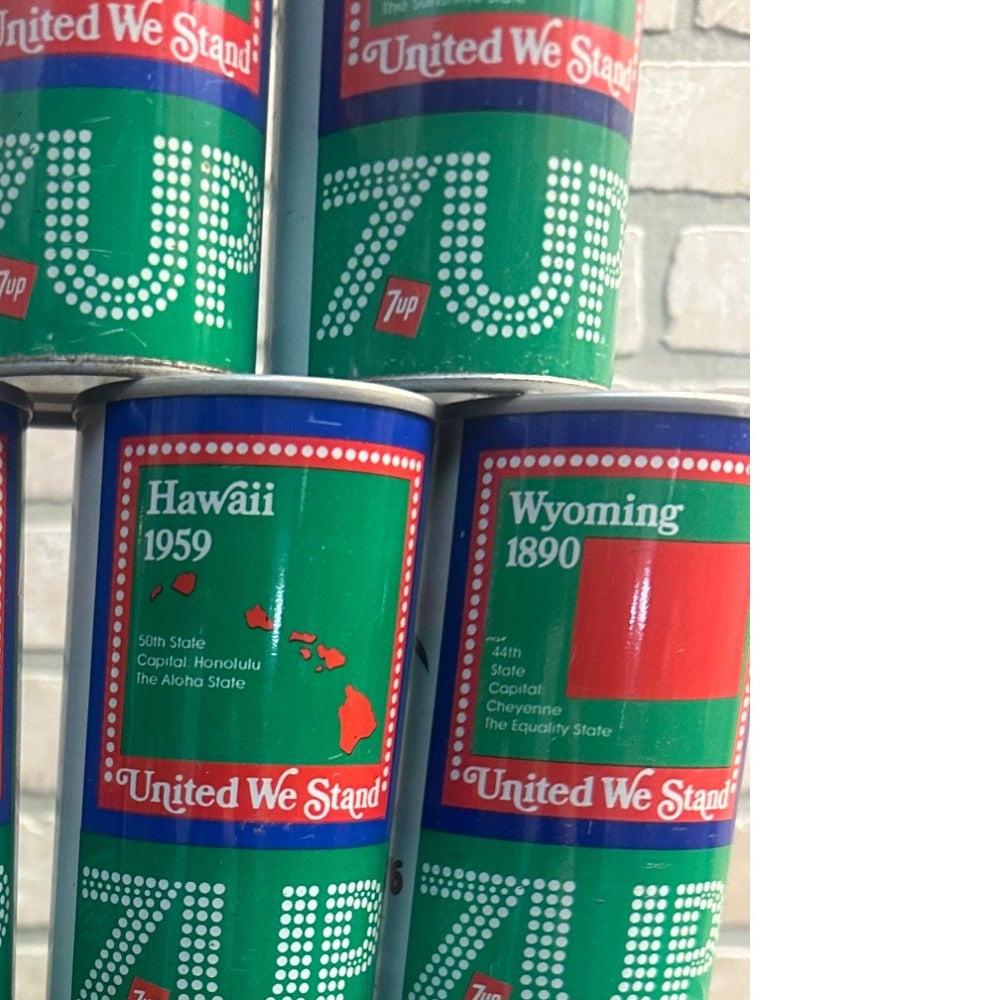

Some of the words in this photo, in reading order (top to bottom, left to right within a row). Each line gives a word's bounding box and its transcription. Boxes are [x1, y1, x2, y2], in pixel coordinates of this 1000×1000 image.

[110, 0, 164, 46] We
[170, 12, 251, 78] Stand
[362, 33, 501, 77] United
[511, 18, 562, 68] We
[567, 36, 634, 97] Stand
[383, 290, 418, 322] 7up
[146, 480, 274, 516] Hawaii
[509, 491, 685, 535] Wyoming
[144, 529, 212, 562] 1959
[506, 536, 580, 569] 1890
[138, 635, 165, 649] 50th
[170, 637, 205, 649] State
[492, 647, 521, 659] 44th
[195, 656, 261, 671] Honolulu
[491, 664, 525, 677] State
[136, 672, 157, 685] The
[162, 674, 203, 687] Aloha
[208, 676, 245, 689] State
[486, 700, 562, 716] Cheyenne
[485, 718, 507, 731] The
[511, 719, 569, 737] Equality
[573, 723, 612, 737] State
[115, 768, 238, 814] United
[247, 768, 299, 809] We
[303, 778, 381, 820] Stand
[463, 766, 593, 812] United
[602, 768, 655, 810] We
[657, 779, 729, 821] Stand
